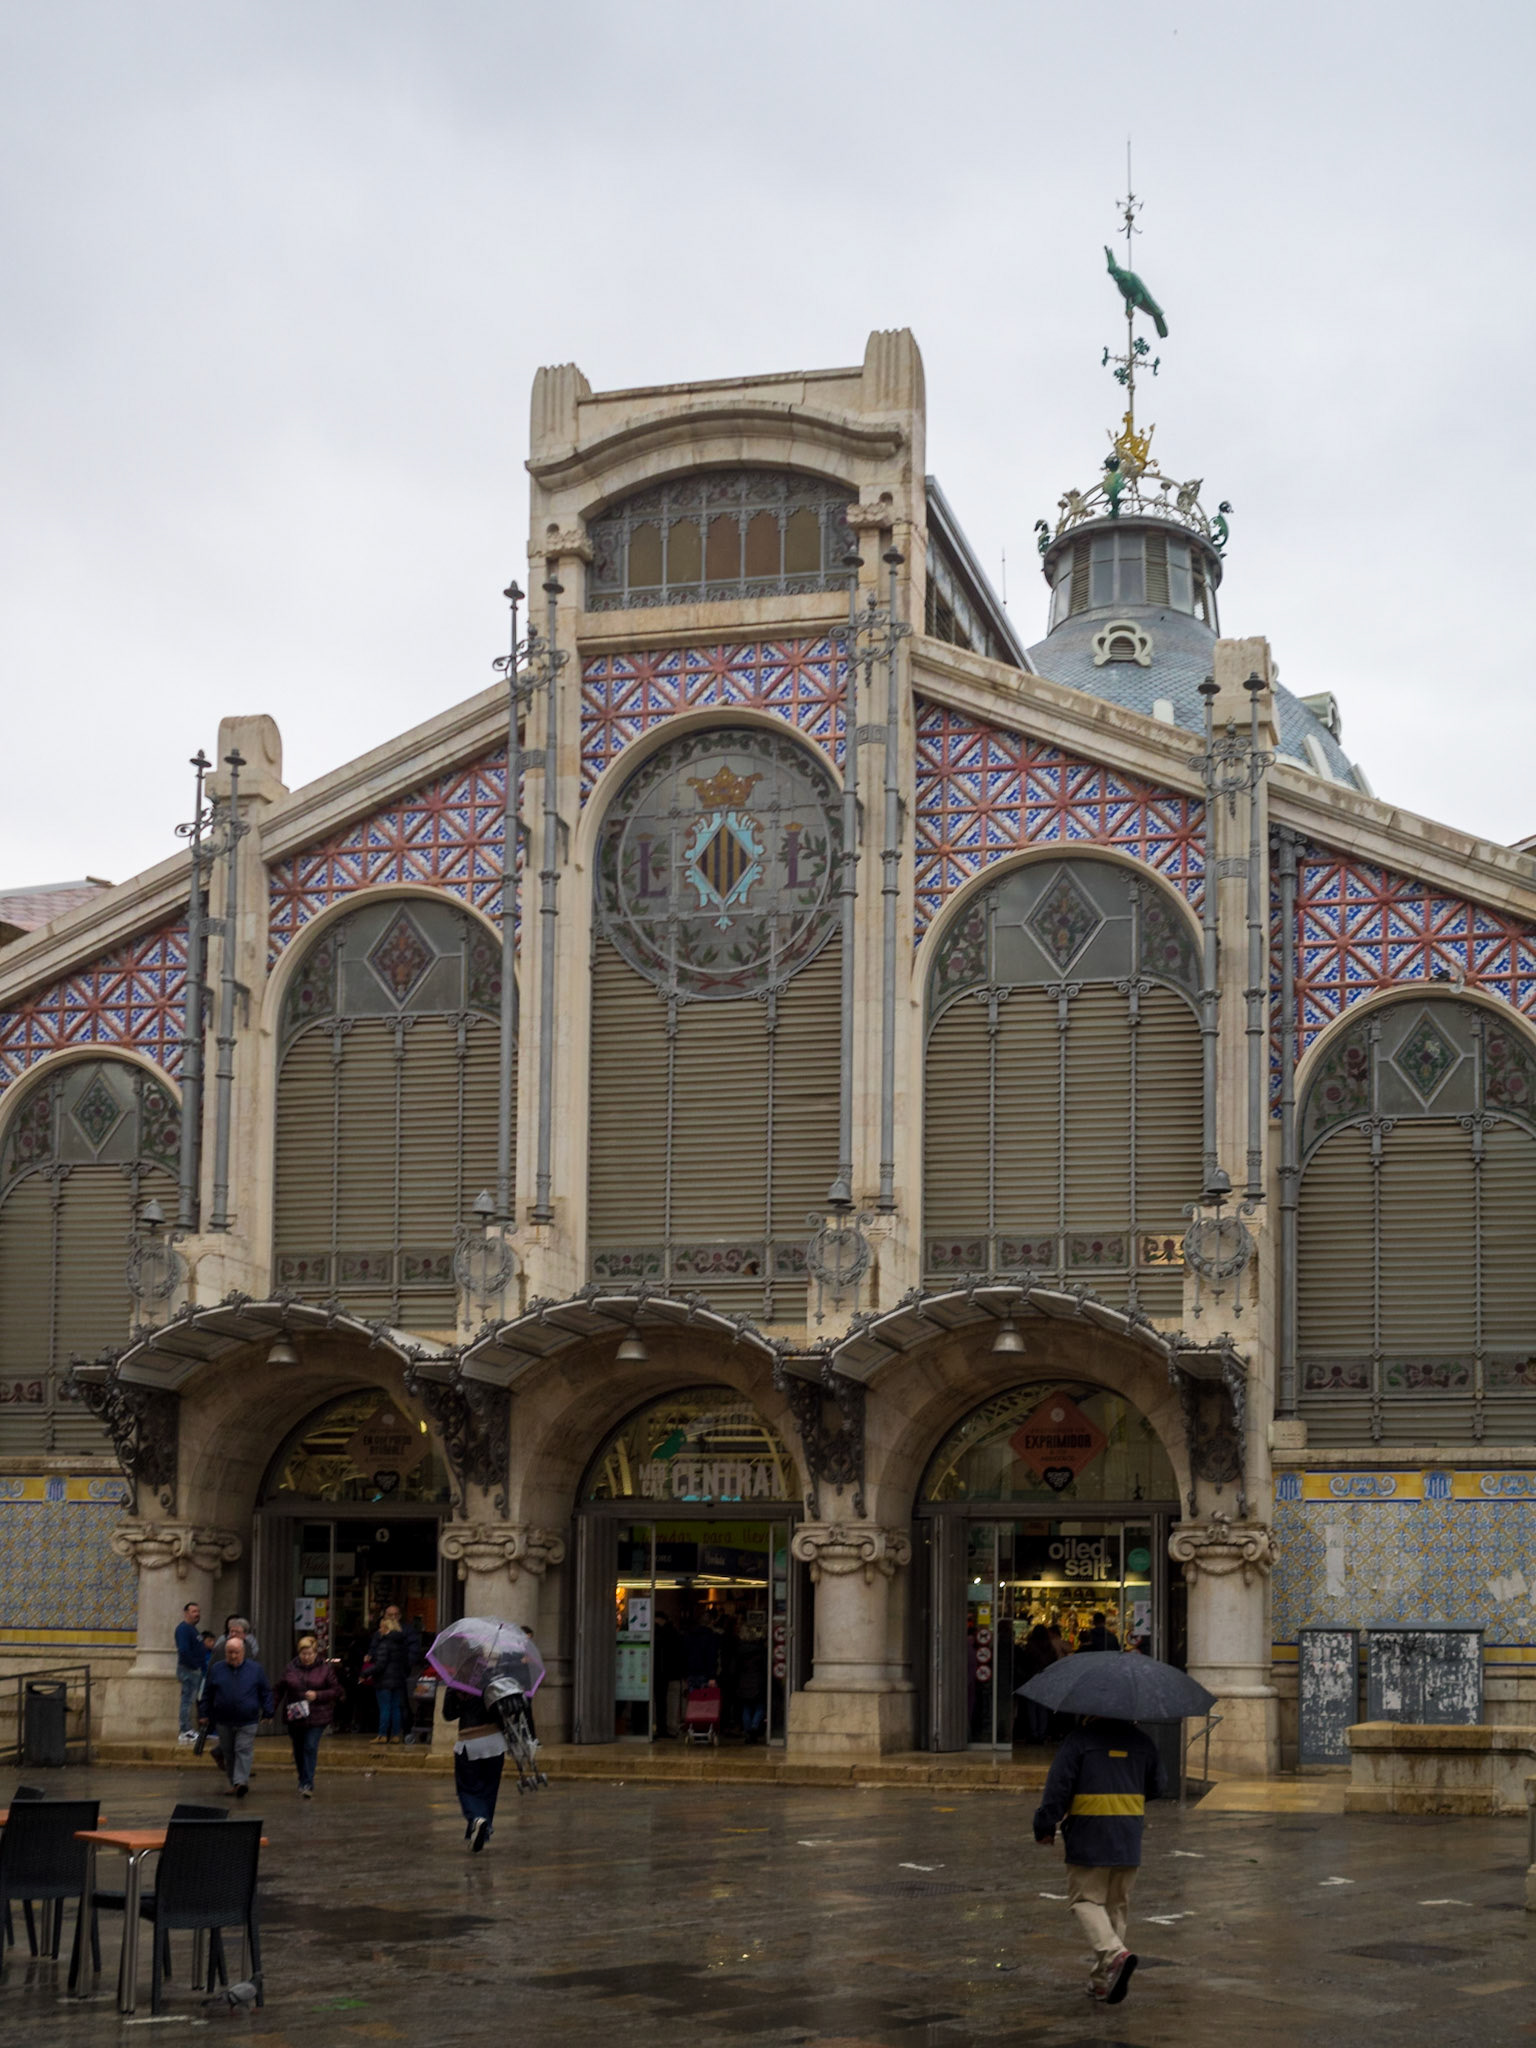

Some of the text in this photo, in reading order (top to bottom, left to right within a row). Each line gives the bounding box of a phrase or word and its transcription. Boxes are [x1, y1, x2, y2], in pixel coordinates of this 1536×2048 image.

[636, 842, 667, 898] L
[784, 832, 816, 889] L
[1025, 1434, 1091, 1448] EXPRIMIDOR
[639, 1463, 665, 1480] MER
[671, 1462, 784, 1498] CENTRAL
[641, 1479, 665, 1497] CAT
[1048, 1537, 1105, 1560] oiled
[1064, 1559, 1112, 1580] salt
